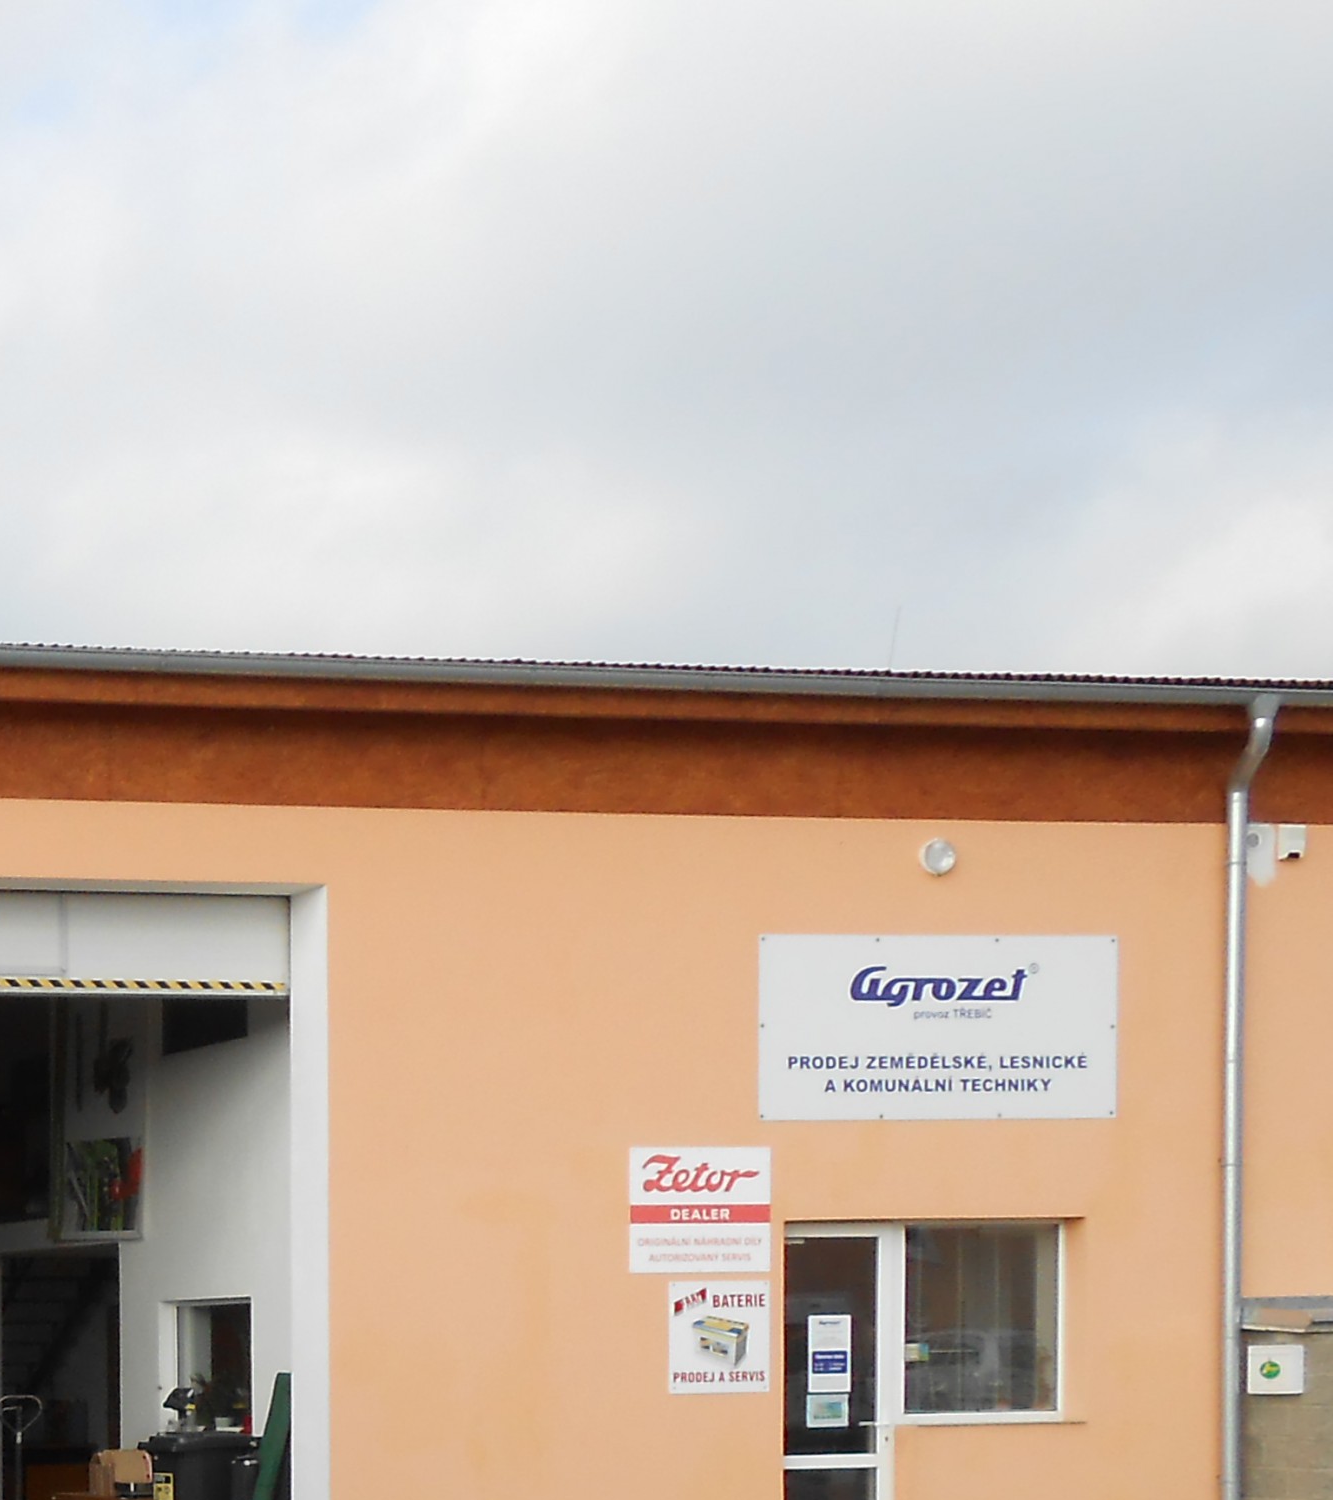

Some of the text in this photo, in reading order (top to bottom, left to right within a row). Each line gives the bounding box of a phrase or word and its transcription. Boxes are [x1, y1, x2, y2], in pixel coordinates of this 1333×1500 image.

[787, 1055, 860, 1070] PRODEJ
[999, 1051, 1088, 1069] LESNICKÉ
[824, 1075, 1052, 1093] A KOMUNÁLNÍ TECHNIKY
[642, 1153, 761, 1193] Zetor
[670, 1208, 731, 1221] DEALER
[712, 1293, 766, 1308] BATERIE
[672, 1370, 766, 1383] PRODEJ A SERVIS
